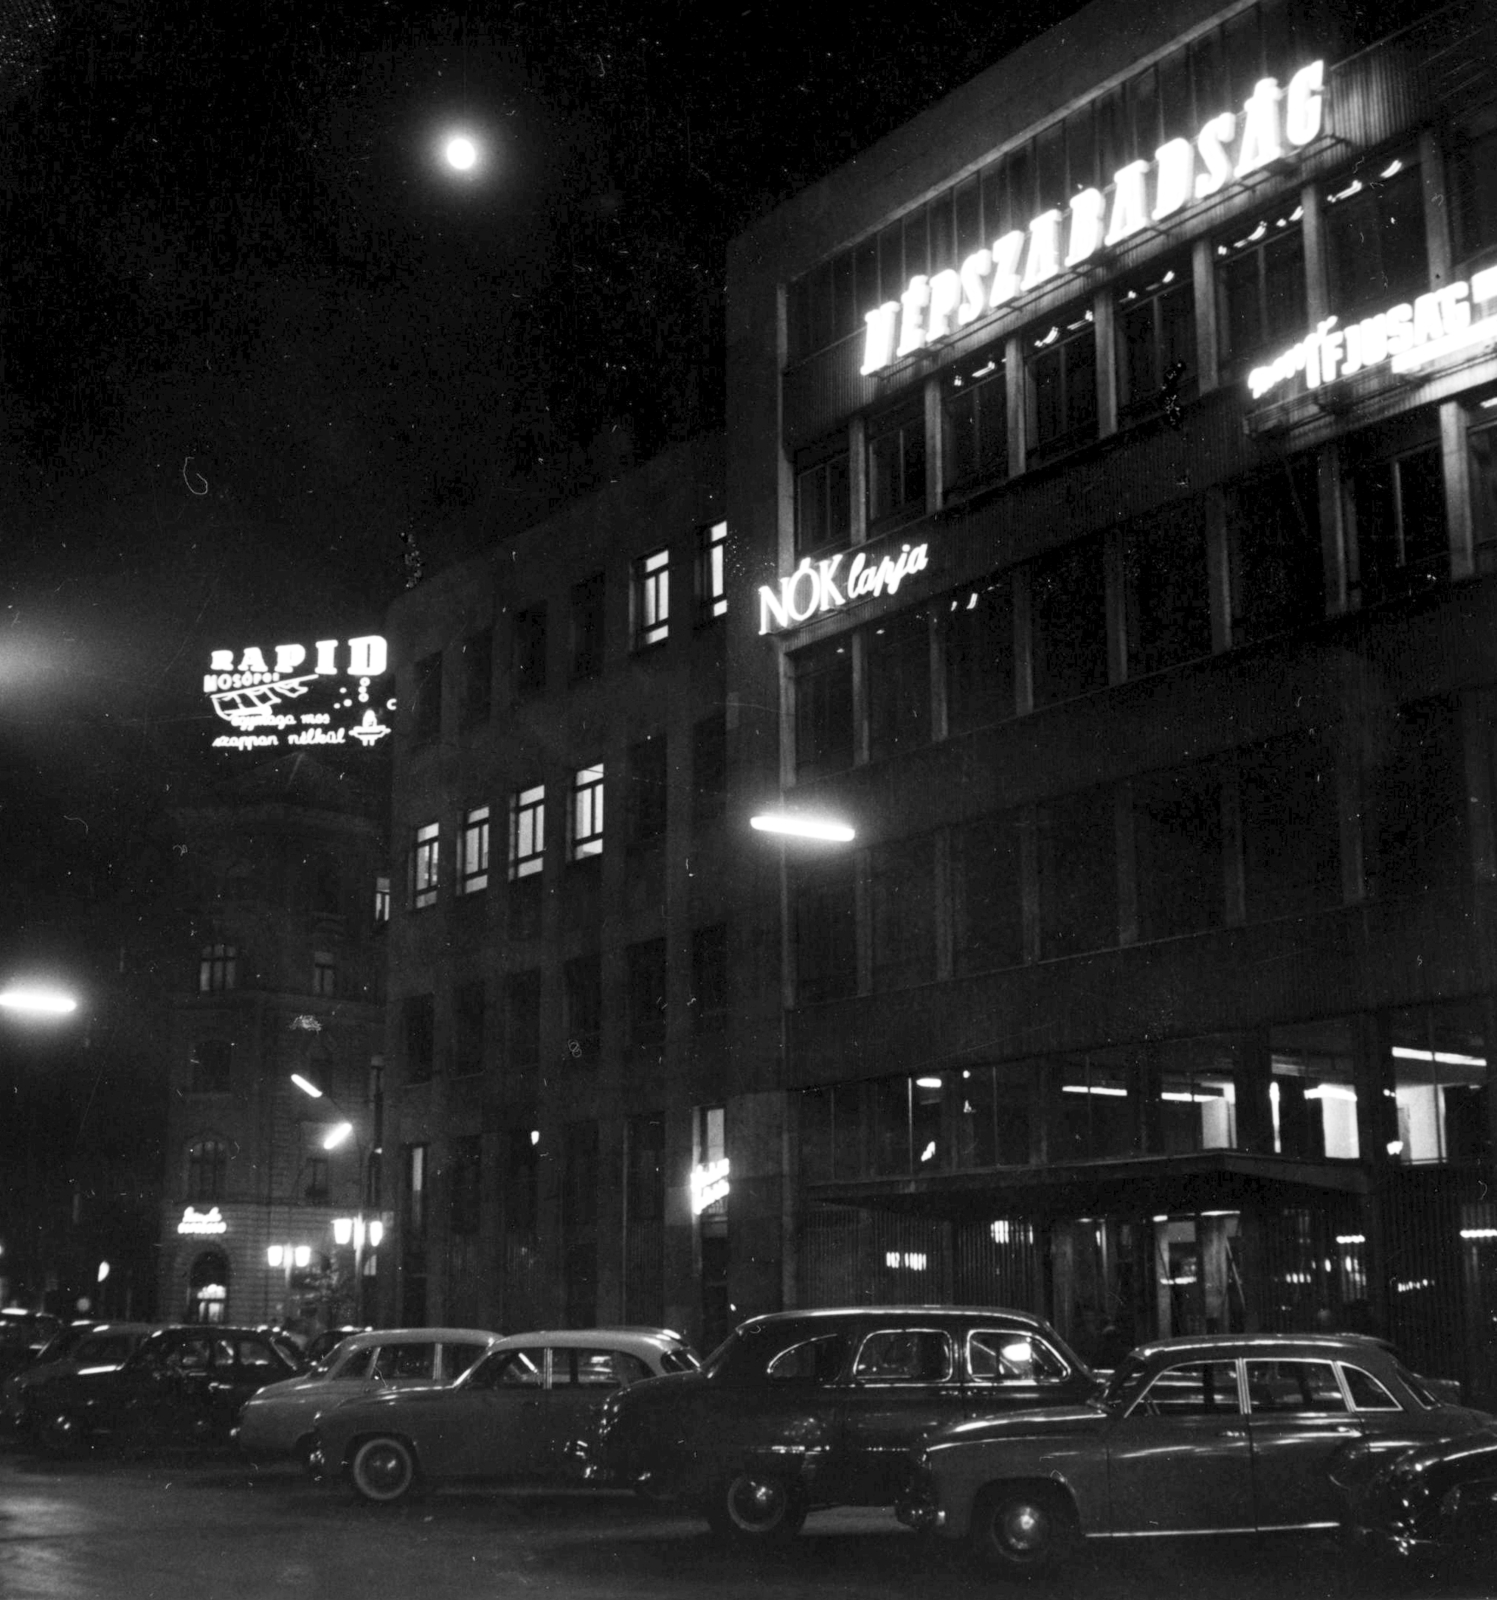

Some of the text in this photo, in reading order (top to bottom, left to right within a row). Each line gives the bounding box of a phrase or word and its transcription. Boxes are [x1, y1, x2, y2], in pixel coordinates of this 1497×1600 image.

[861, 60, 1324, 376] NÉPSZABADSÁG
[847, 543, 929, 599] lapja
[210, 635, 388, 676] RAPID
